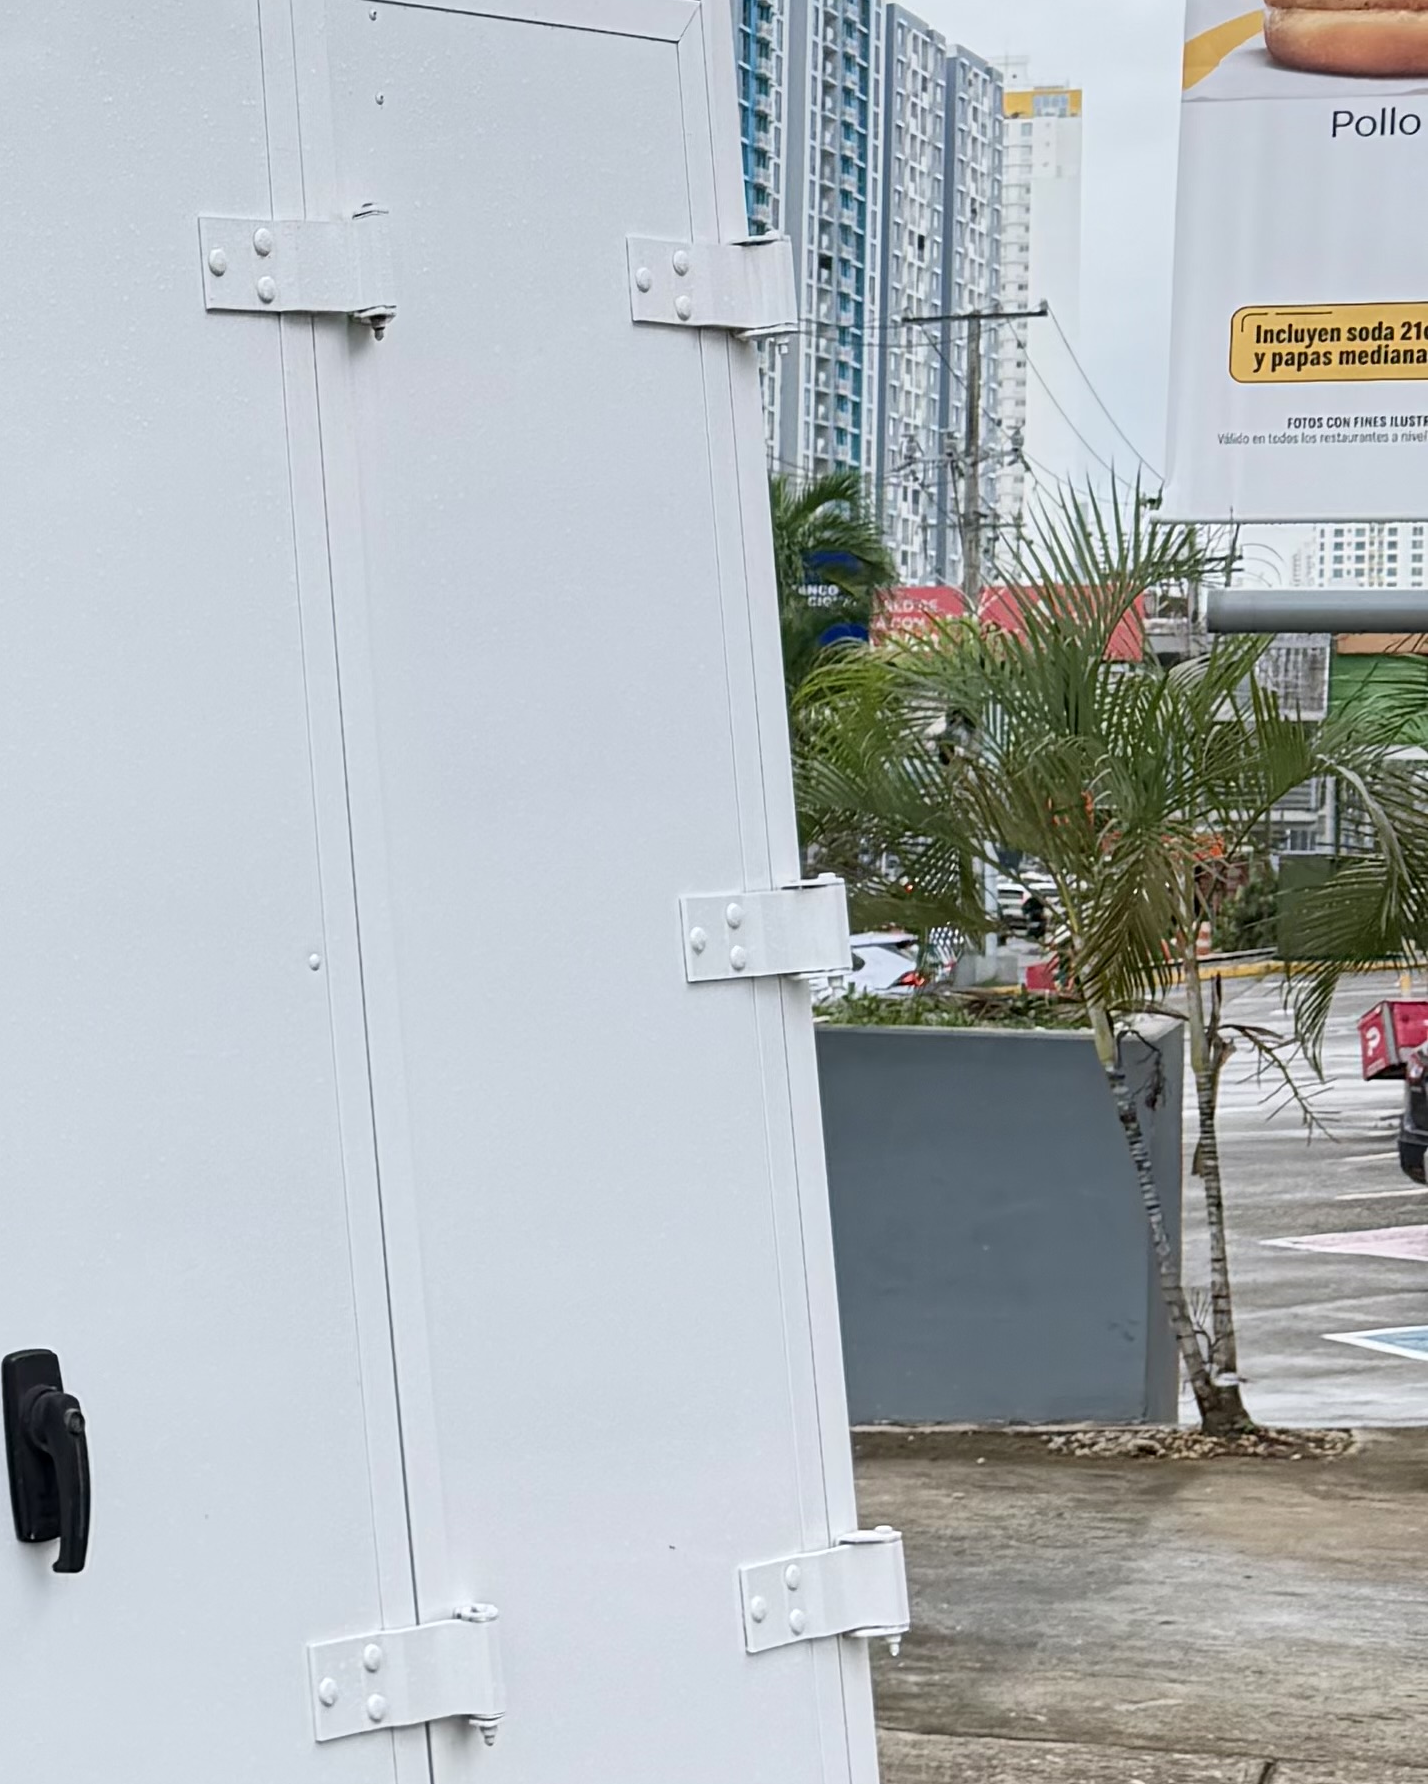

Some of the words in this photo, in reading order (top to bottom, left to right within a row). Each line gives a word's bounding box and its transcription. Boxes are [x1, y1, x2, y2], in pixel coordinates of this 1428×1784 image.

[1332, 106, 1422, 138] Pollo
[1254, 323, 1342, 349] Incluyen
[1346, 320, 1395, 342] soda
[1252, 351, 1266, 373] y
[1270, 350, 1333, 373] papas
[1338, 344, 1428, 366] mediana
[1287, 417, 1324, 429] FOTOS
[1326, 417, 1351, 429] CON
[1353, 416, 1387, 428] FINES
[1217, 431, 1250, 445] Válido
[1252, 434, 1267, 445] en
[1268, 432, 1299, 445] todos
[1301, 431, 1318, 444] los
[1319, 430, 1390, 445] restaurantes
